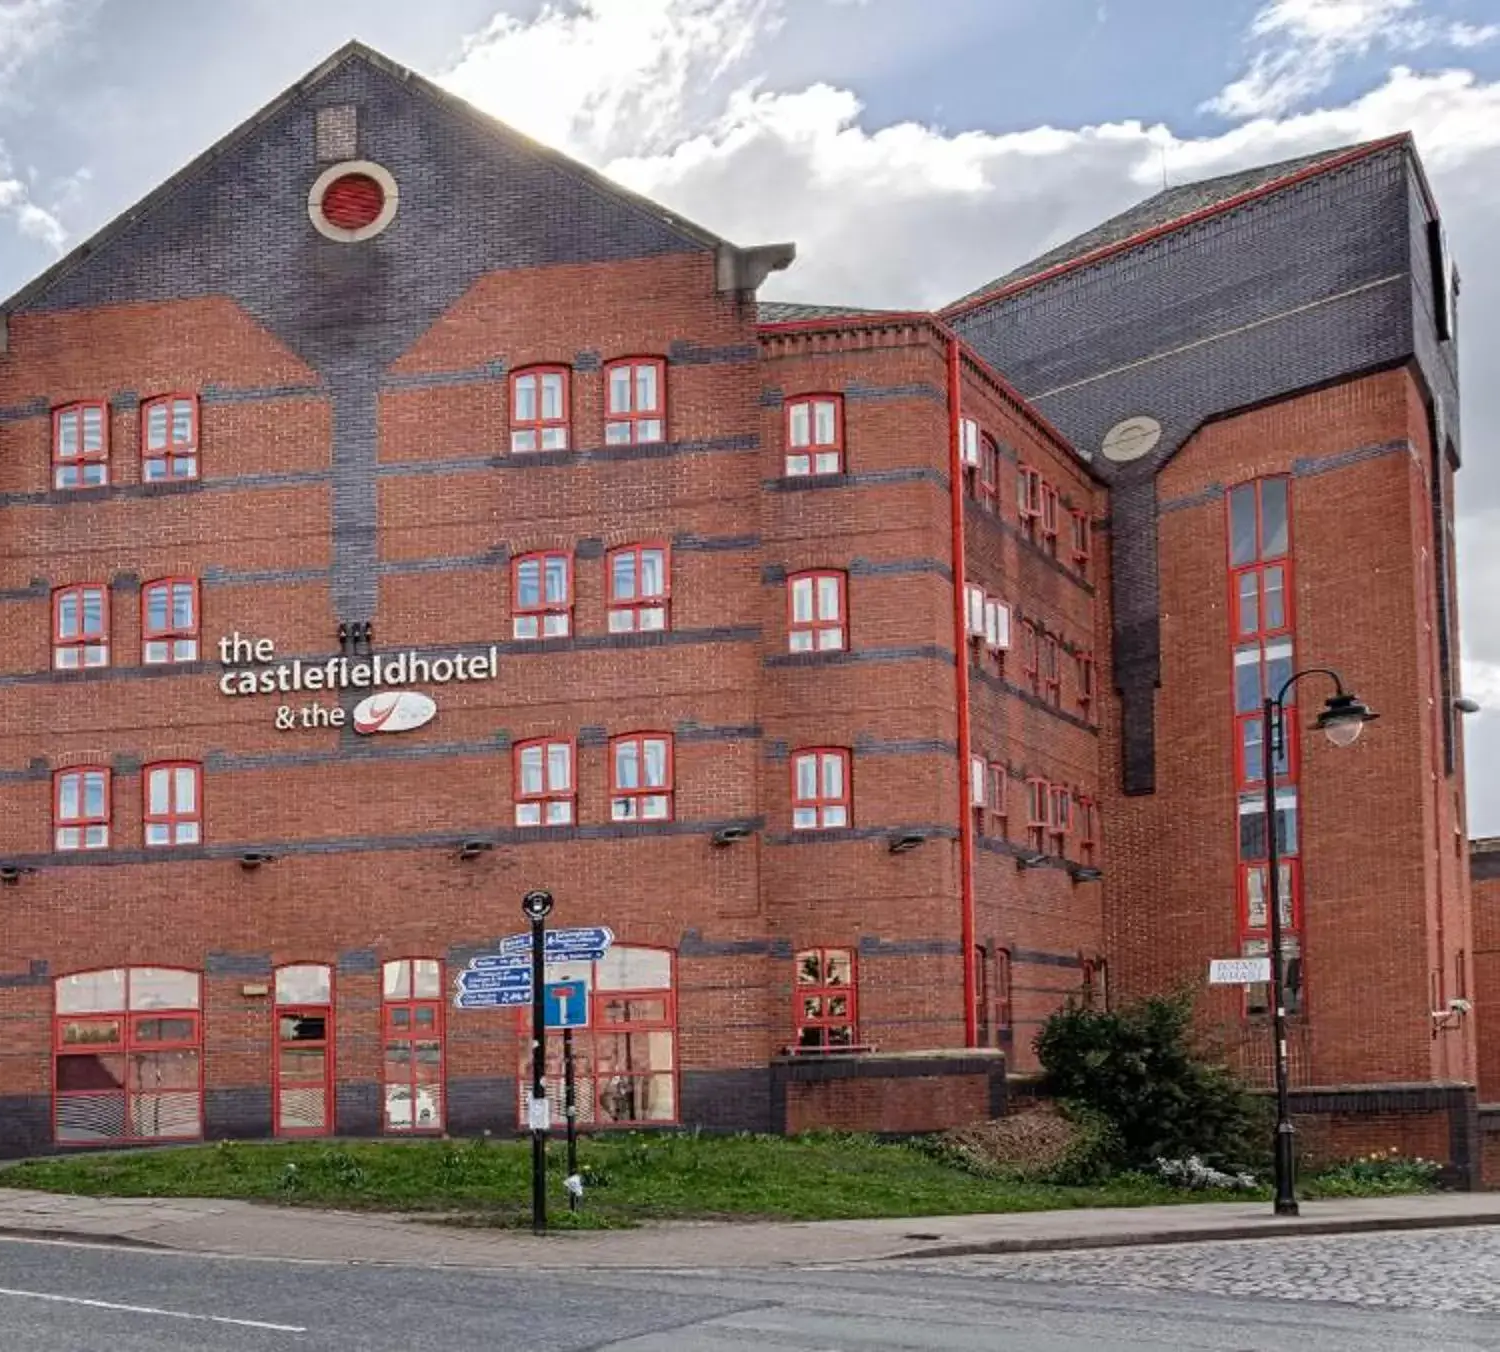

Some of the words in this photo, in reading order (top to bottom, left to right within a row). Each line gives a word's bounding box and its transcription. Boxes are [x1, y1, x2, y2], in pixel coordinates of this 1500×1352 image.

[218, 632, 274, 664] the
[219, 646, 498, 695] castlefieldhotel
[275, 705, 296, 730] &
[300, 703, 345, 728] the
